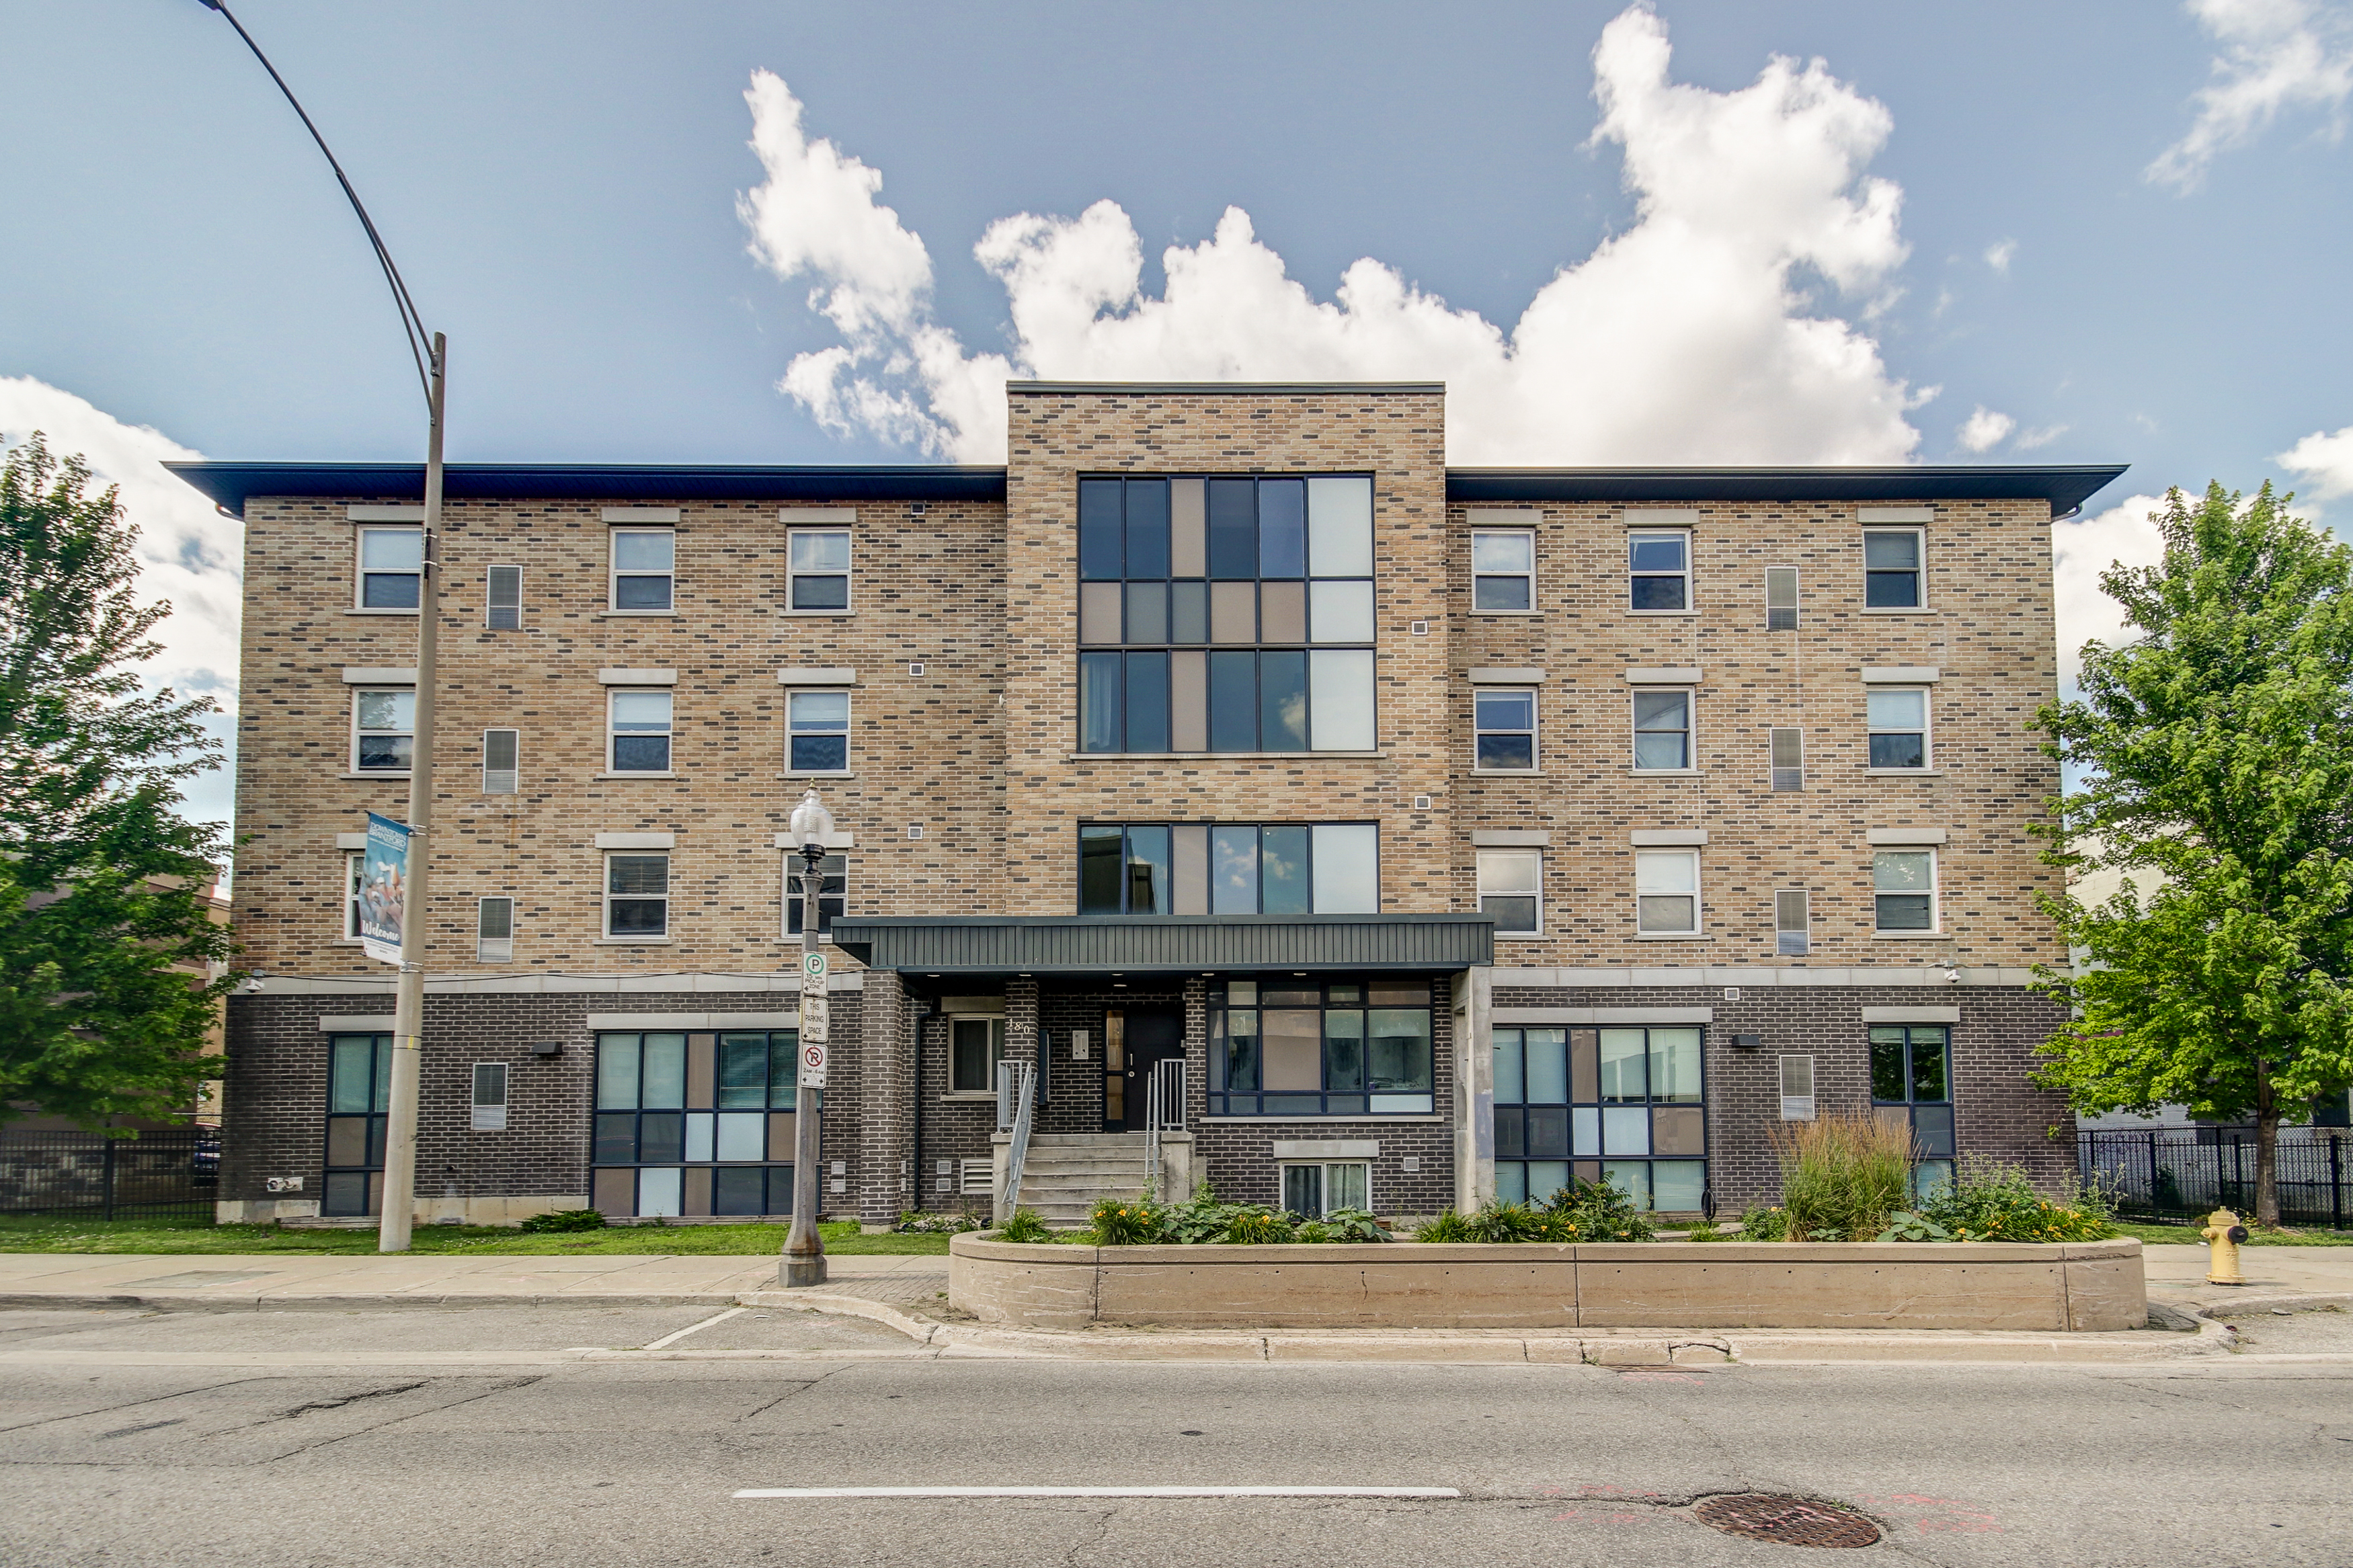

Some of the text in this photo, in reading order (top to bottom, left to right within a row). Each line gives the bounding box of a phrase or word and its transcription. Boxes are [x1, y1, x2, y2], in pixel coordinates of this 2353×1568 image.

[369, 827, 406, 847] BRANTFORD
[370, 821, 407, 841] DOWNTOWN
[362, 919, 400, 941] Welcome
[812, 959, 820, 969] P
[805, 1014, 824, 1023] PARKING
[807, 1026, 822, 1035] SPACE
[1008, 1018, 1030, 1034] 180
[811, 1052, 819, 1063] P
